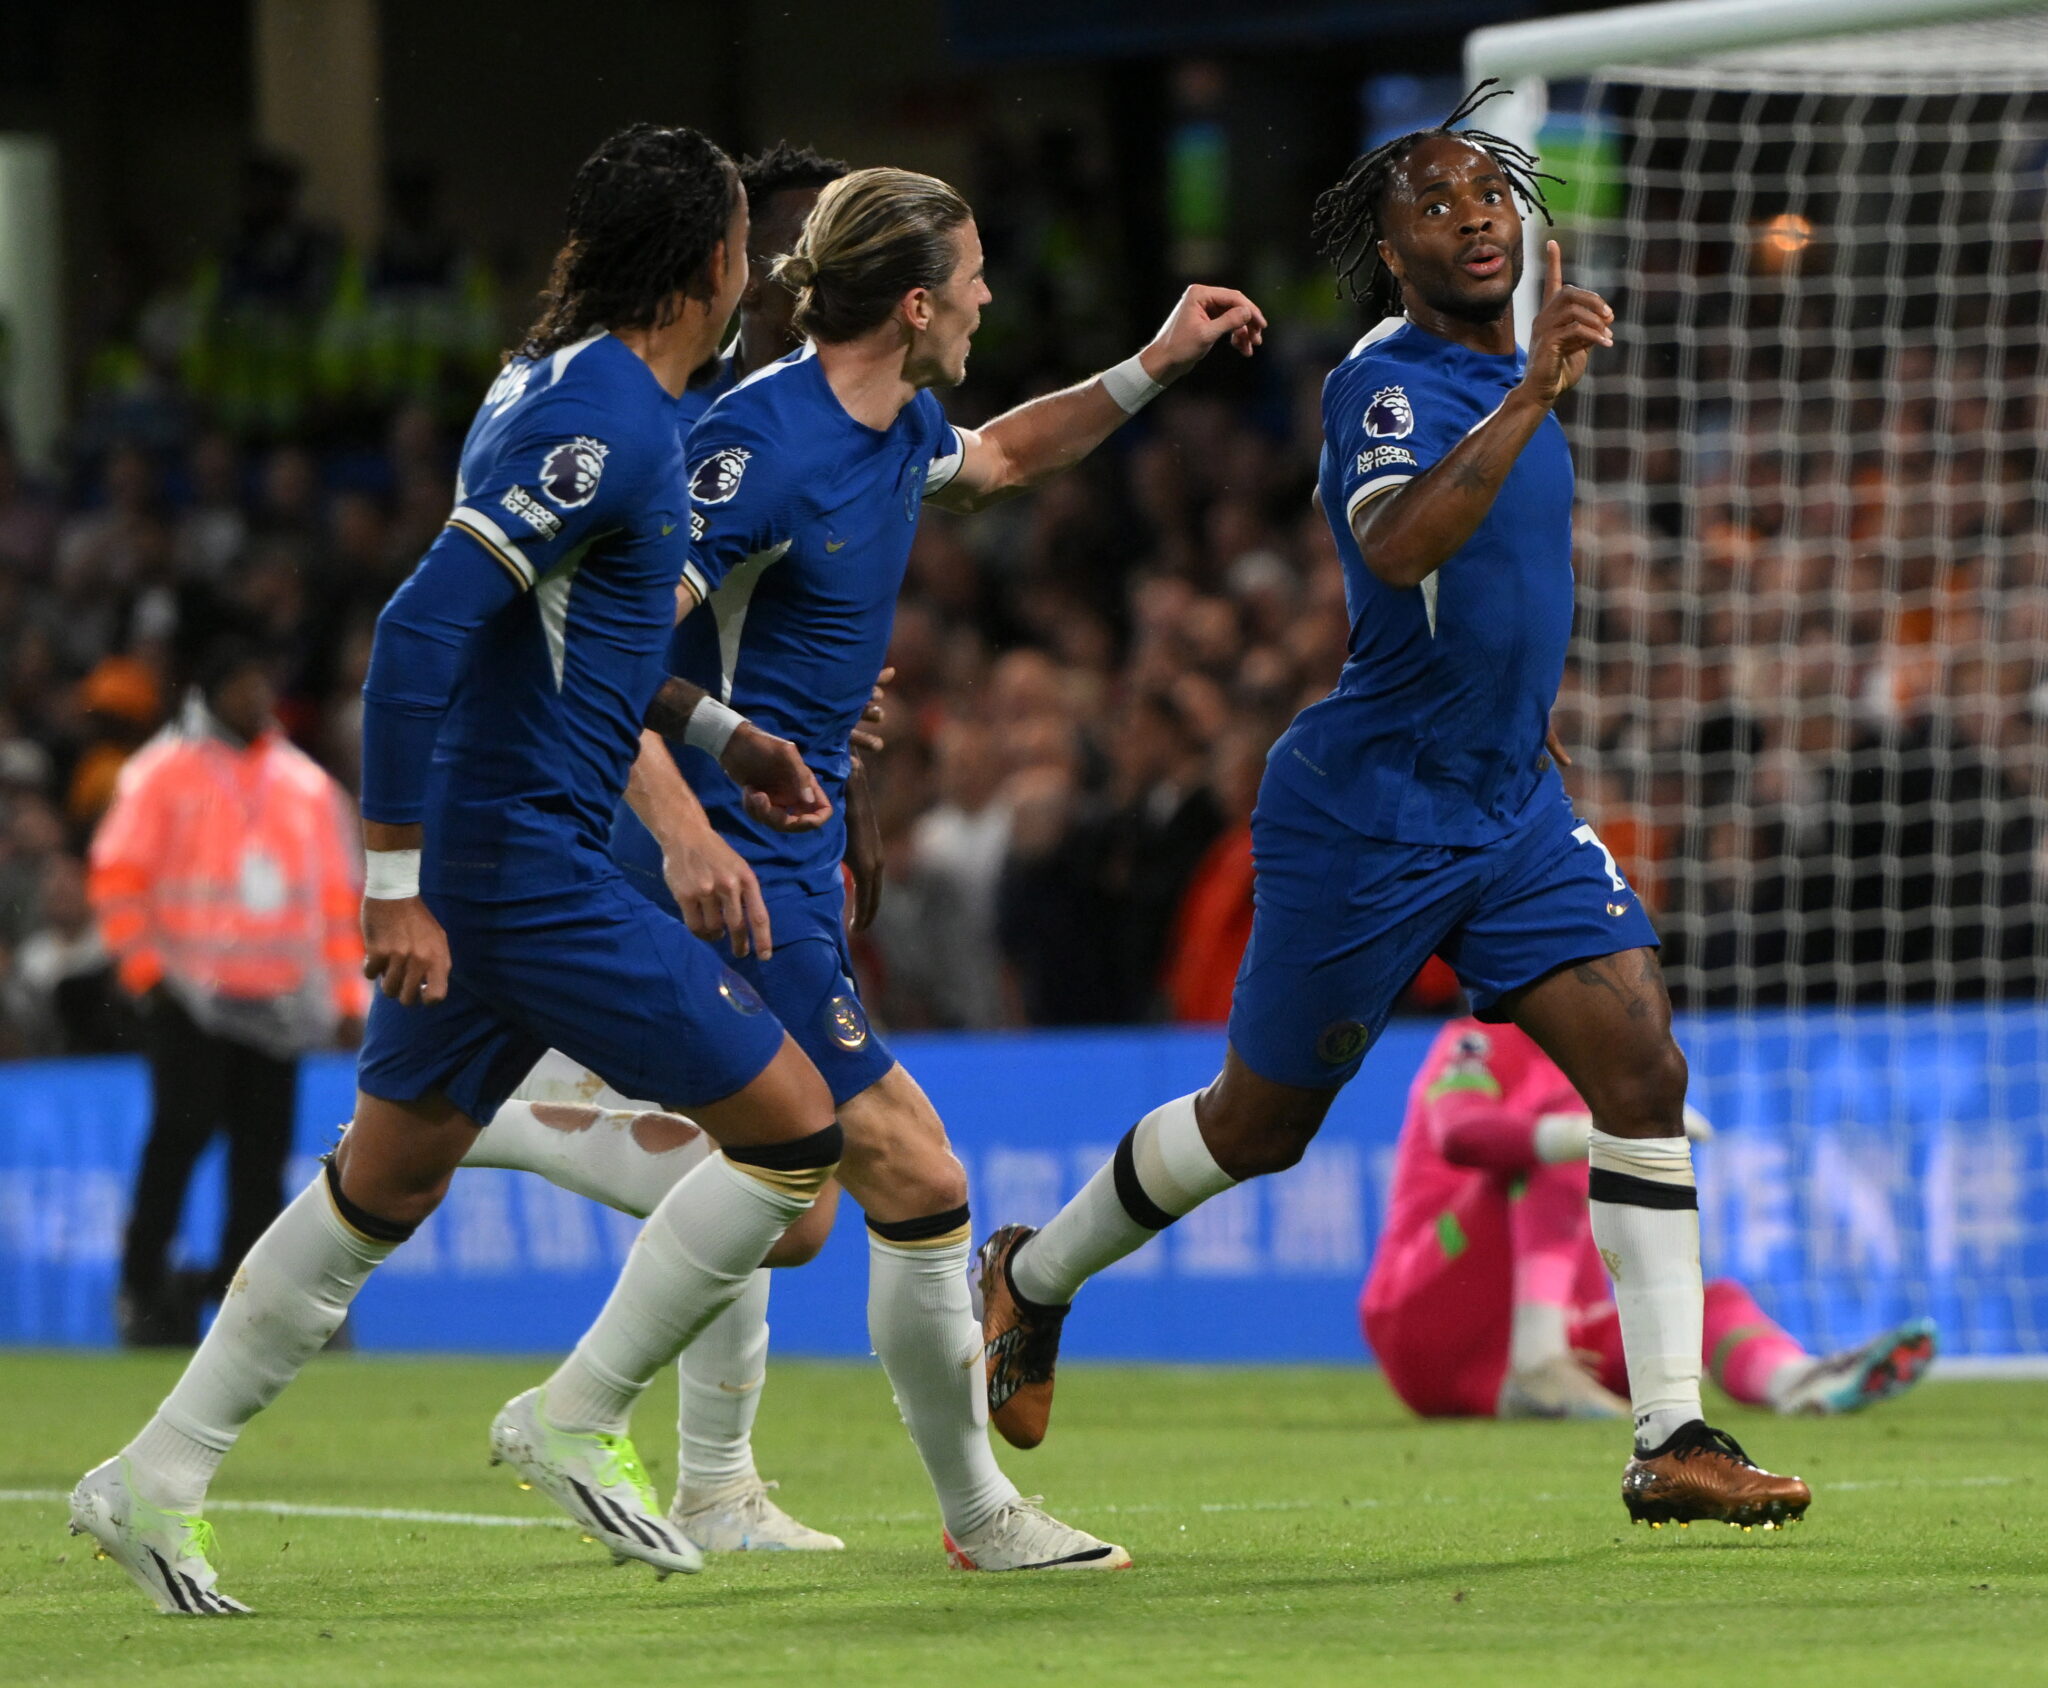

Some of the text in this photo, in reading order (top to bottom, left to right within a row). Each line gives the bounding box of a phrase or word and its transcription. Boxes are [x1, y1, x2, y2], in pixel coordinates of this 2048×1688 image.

[1357, 445, 1410, 463] No room
[1375, 455, 1418, 467] racism
[506, 484, 562, 531] No room
[1571, 824, 1626, 892] 7
